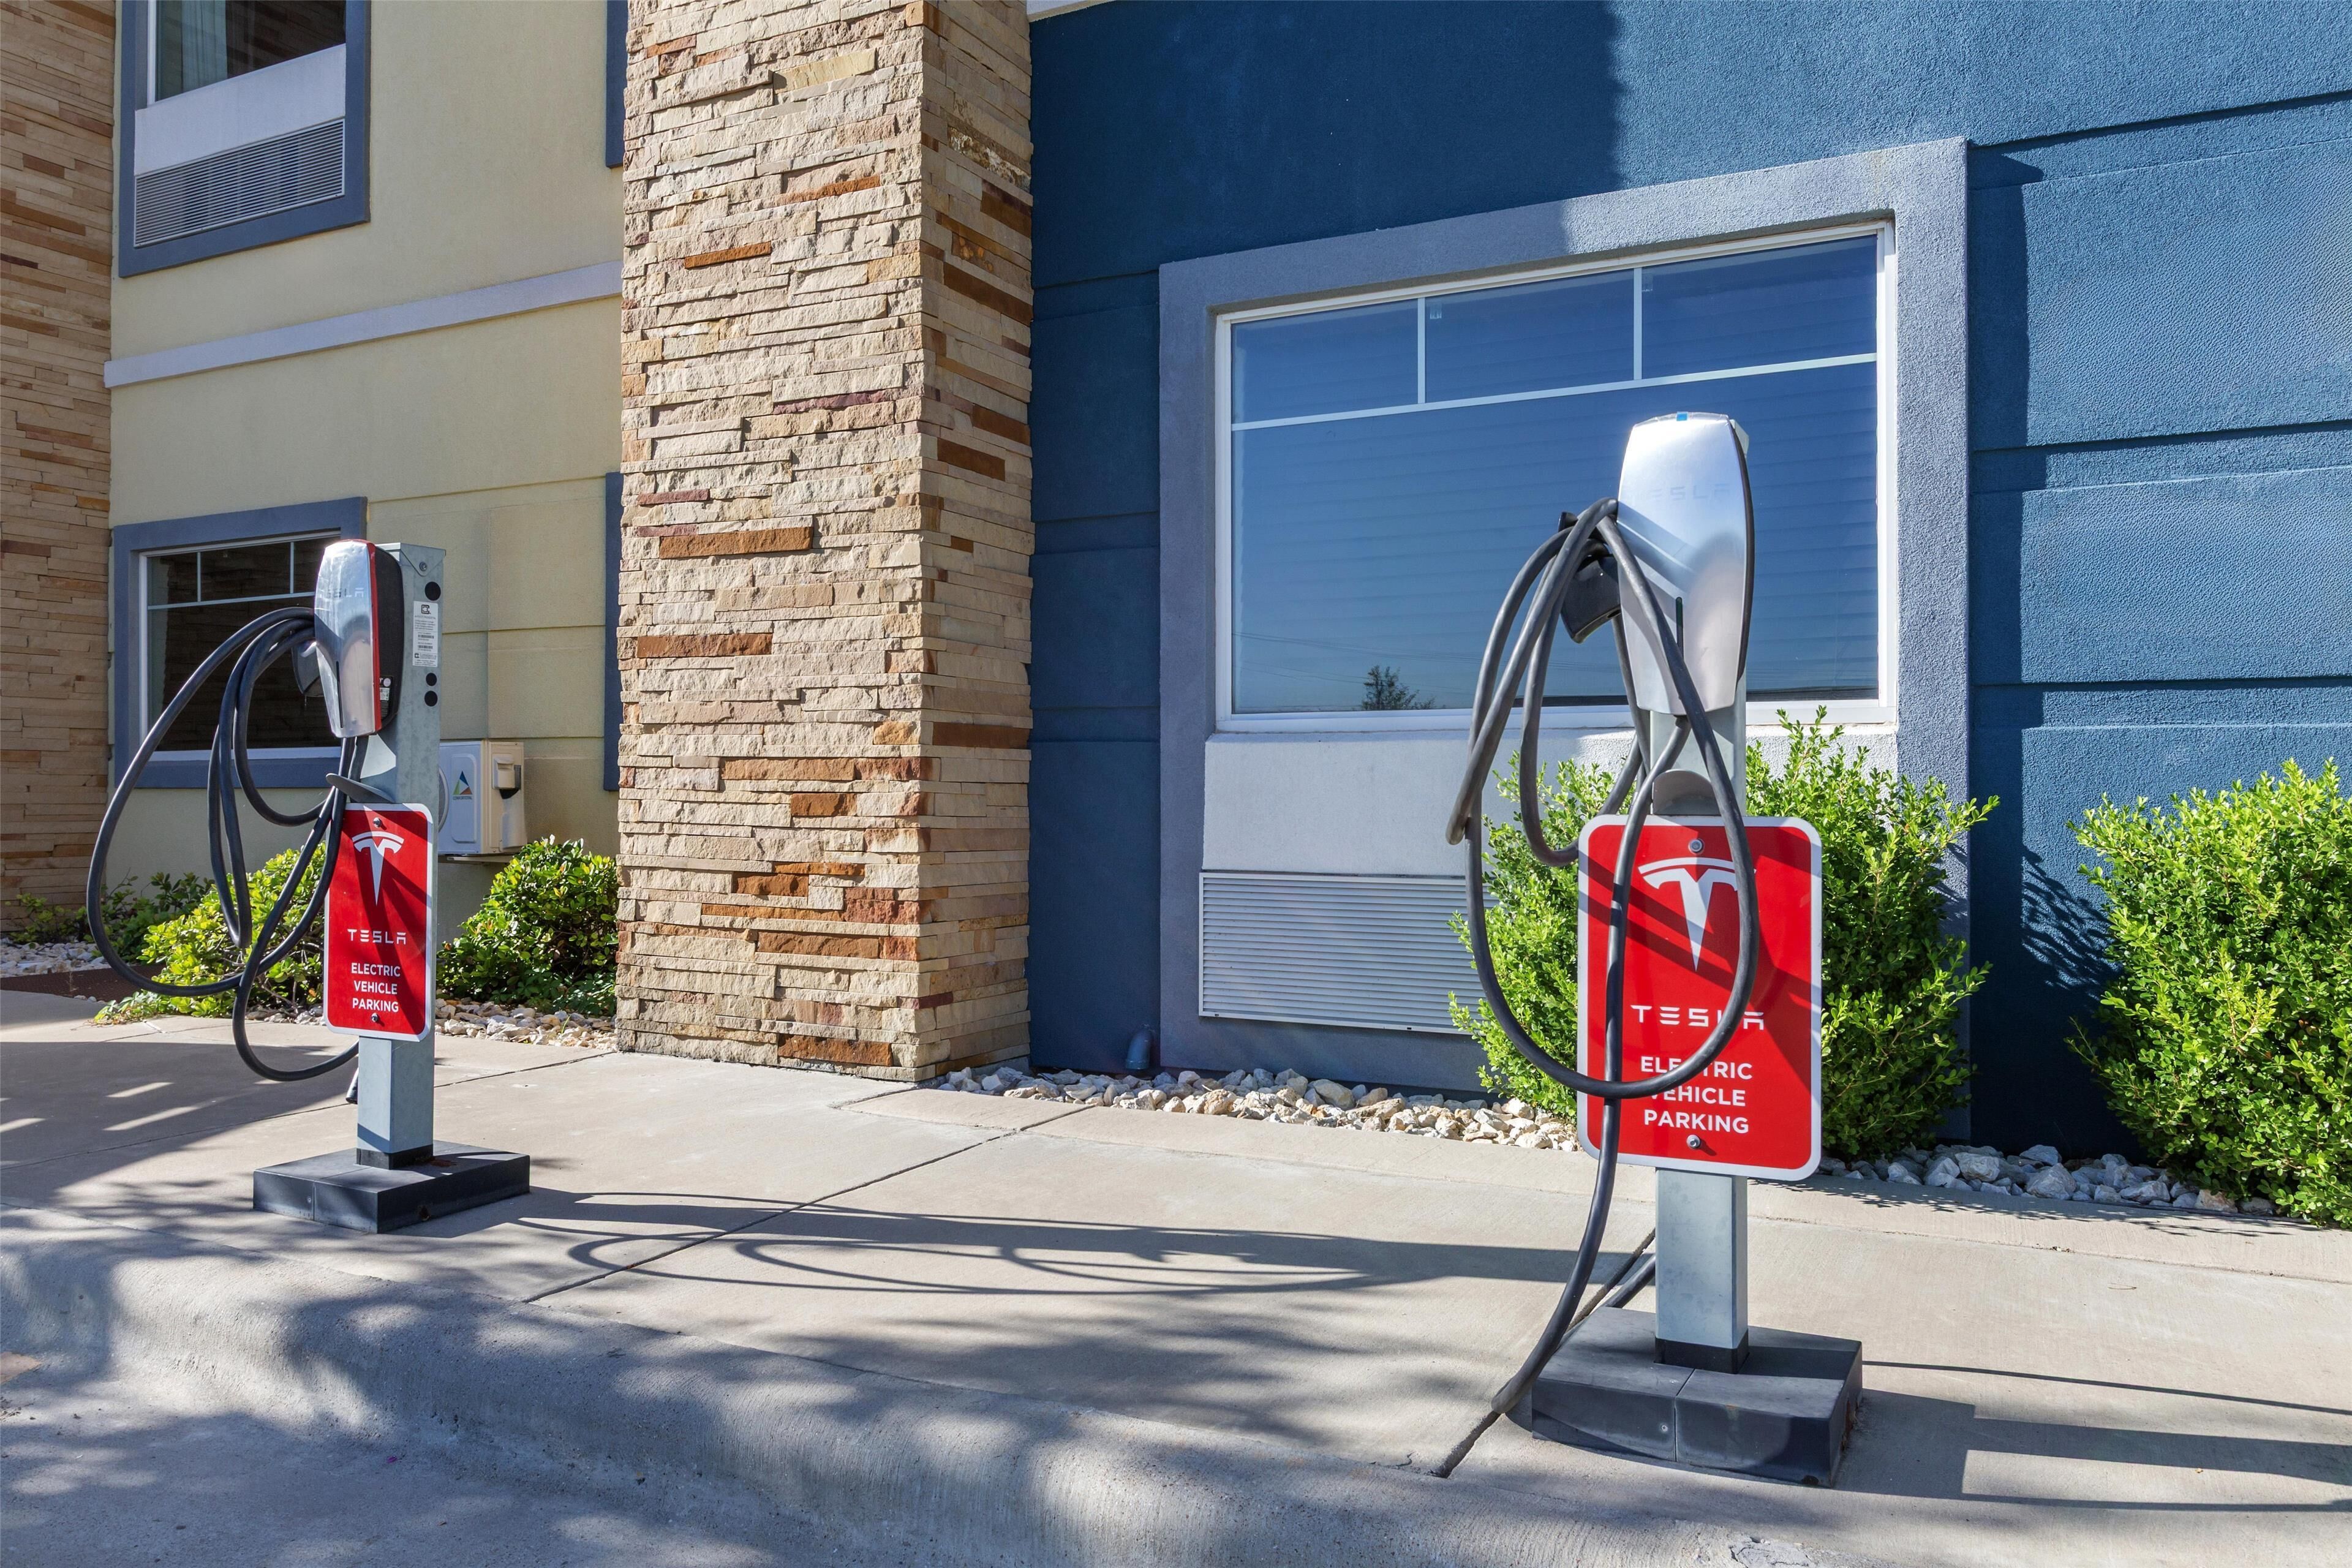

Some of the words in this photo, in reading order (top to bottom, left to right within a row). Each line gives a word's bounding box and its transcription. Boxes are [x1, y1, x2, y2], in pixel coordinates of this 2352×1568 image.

[1644, 483, 1731, 502] ESLA
[347, 929, 406, 944] TESLA
[351, 962, 401, 977] ELECTRIC
[353, 980, 398, 995] VEHICLE
[352, 997, 399, 1012] PARKING
[1641, 1056, 1752, 1080] ELERIC
[1650, 1085, 1746, 1107] EHICLE
[1644, 1109, 1749, 1134] PARKING
